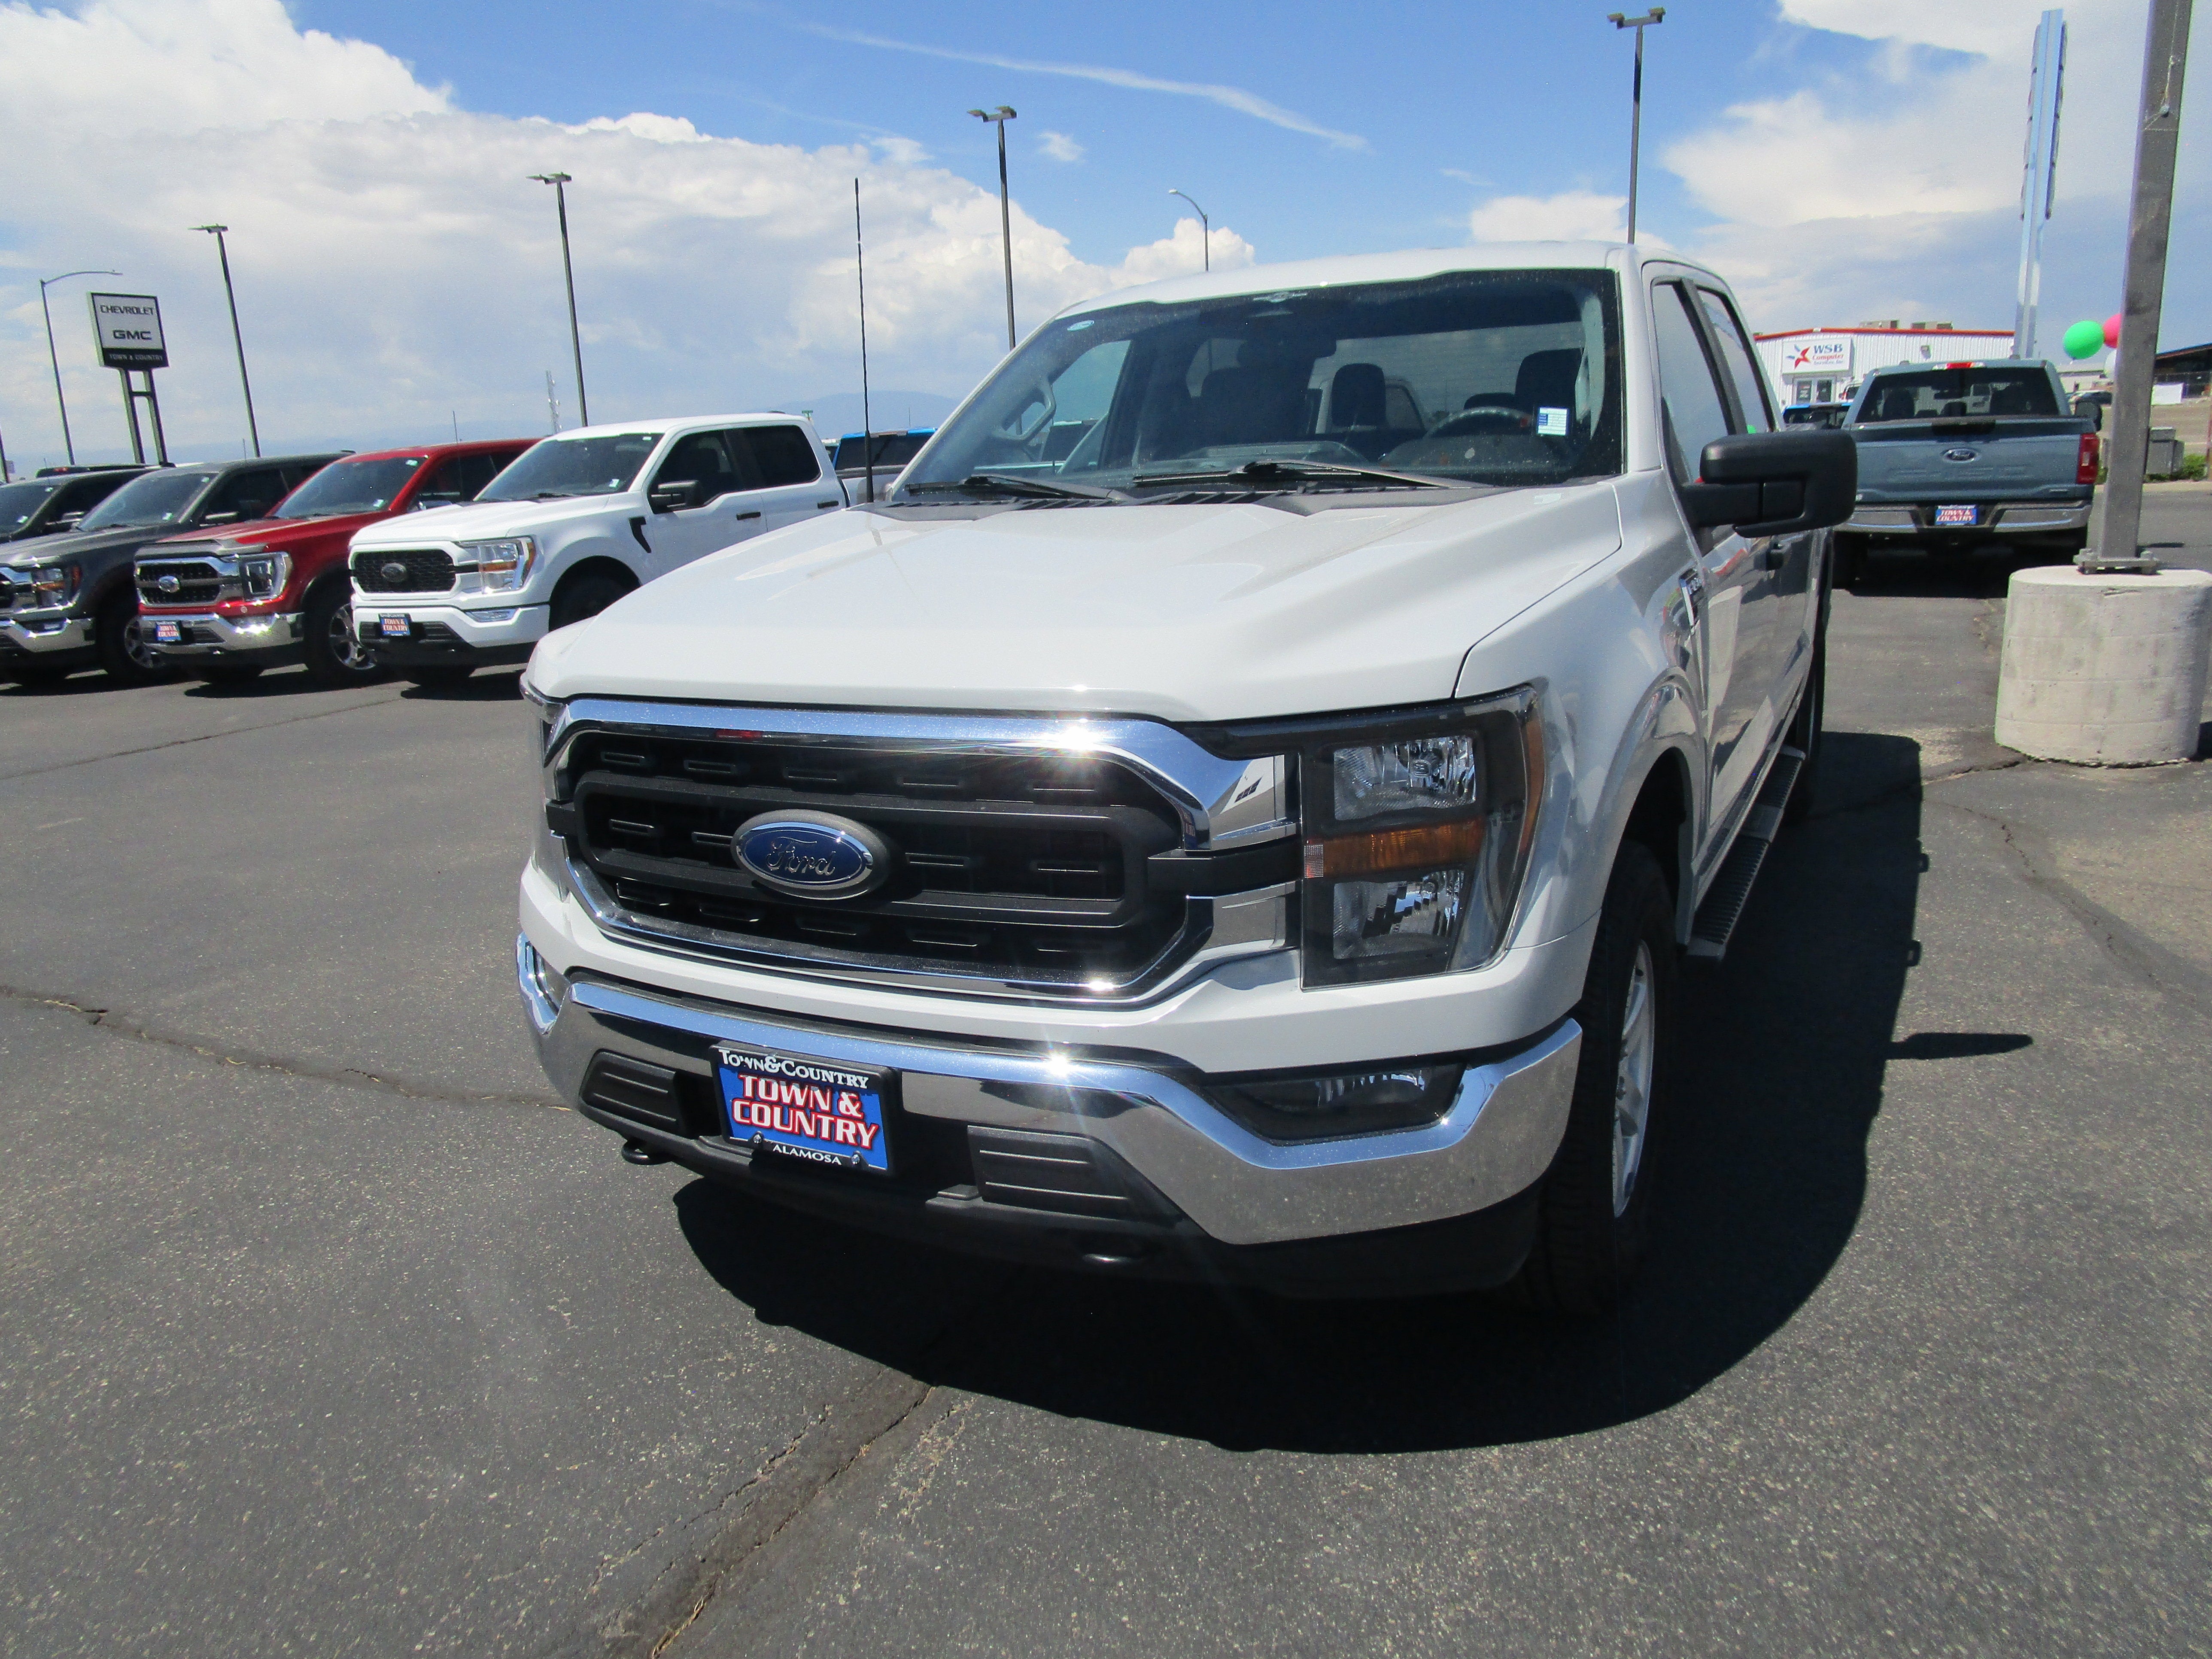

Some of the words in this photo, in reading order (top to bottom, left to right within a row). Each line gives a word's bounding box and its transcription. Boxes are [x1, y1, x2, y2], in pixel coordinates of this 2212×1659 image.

[100, 305, 154, 315] CHEVROLET
[113, 330, 152, 340] GMC
[1814, 344, 1843, 353] WSB
[766, 837, 836, 876] Ford
[738, 1074, 832, 1112] TOWN
[838, 1090, 864, 1119] &
[732, 1098, 879, 1149] COUNTRY
[772, 1144, 842, 1165] ALAMOSA
